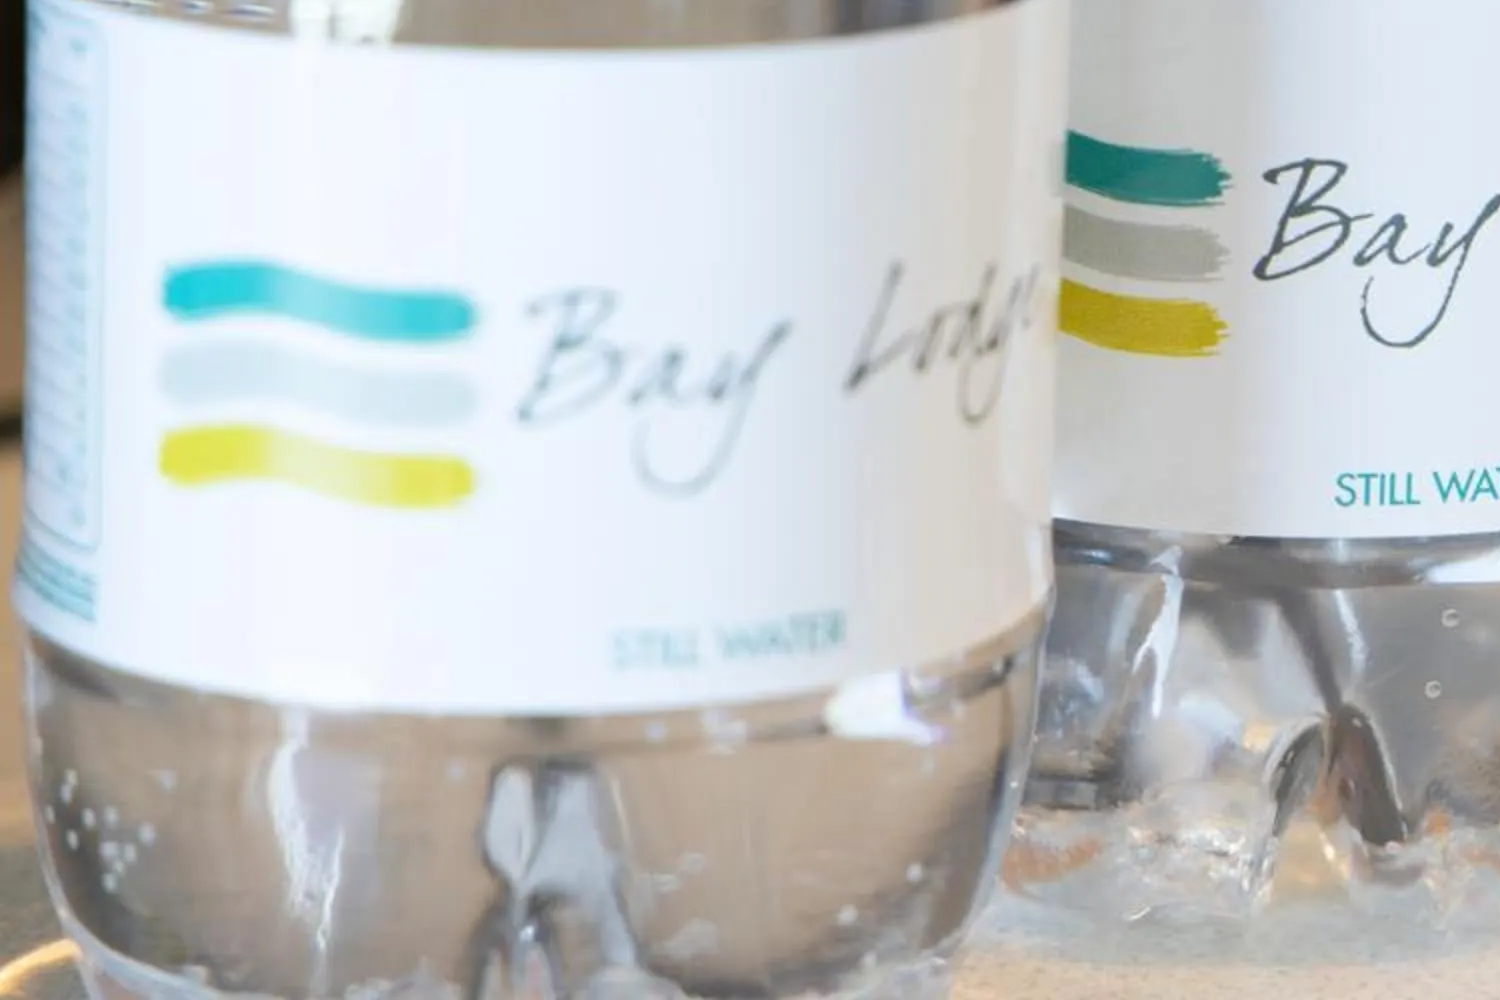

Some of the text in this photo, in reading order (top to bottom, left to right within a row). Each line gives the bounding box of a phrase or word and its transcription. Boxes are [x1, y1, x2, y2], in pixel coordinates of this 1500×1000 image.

[516, 284, 794, 497] Bay
[1334, 472, 1421, 507] STILL
[714, 608, 846, 658] WATER
